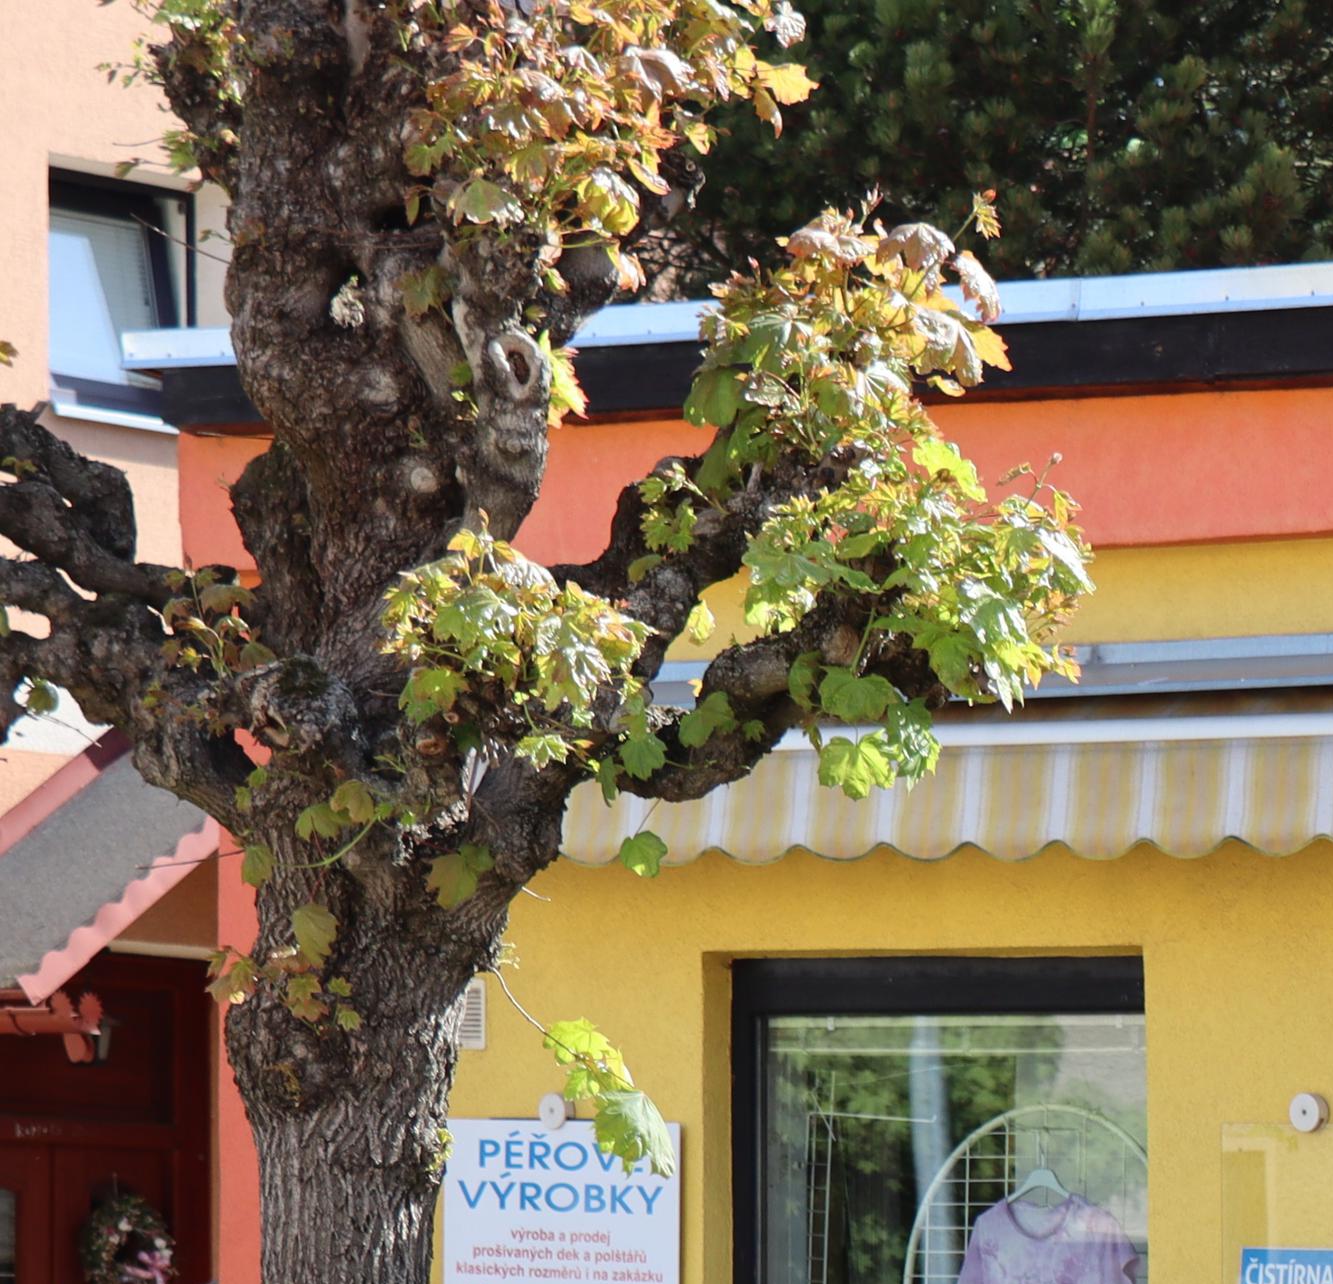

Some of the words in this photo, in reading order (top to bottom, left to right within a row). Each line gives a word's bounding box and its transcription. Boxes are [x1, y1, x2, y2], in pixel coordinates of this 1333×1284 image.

[479, 1130, 643, 1173] PÉŘOV
[458, 1172, 663, 1214] VÝROBKY
[511, 1227, 555, 1243] výroba
[559, 1232, 566, 1241] a
[570, 1230, 610, 1246] prodej
[473, 1244, 553, 1262] prošívaných
[557, 1249, 579, 1261] dek
[584, 1252, 591, 1261] a
[595, 1249, 647, 1264] polštářů
[456, 1262, 524, 1279] klasických
[528, 1265, 581, 1279] rozměrů
[593, 1271, 608, 1281] na
[612, 1268, 663, 1283] zakázku
